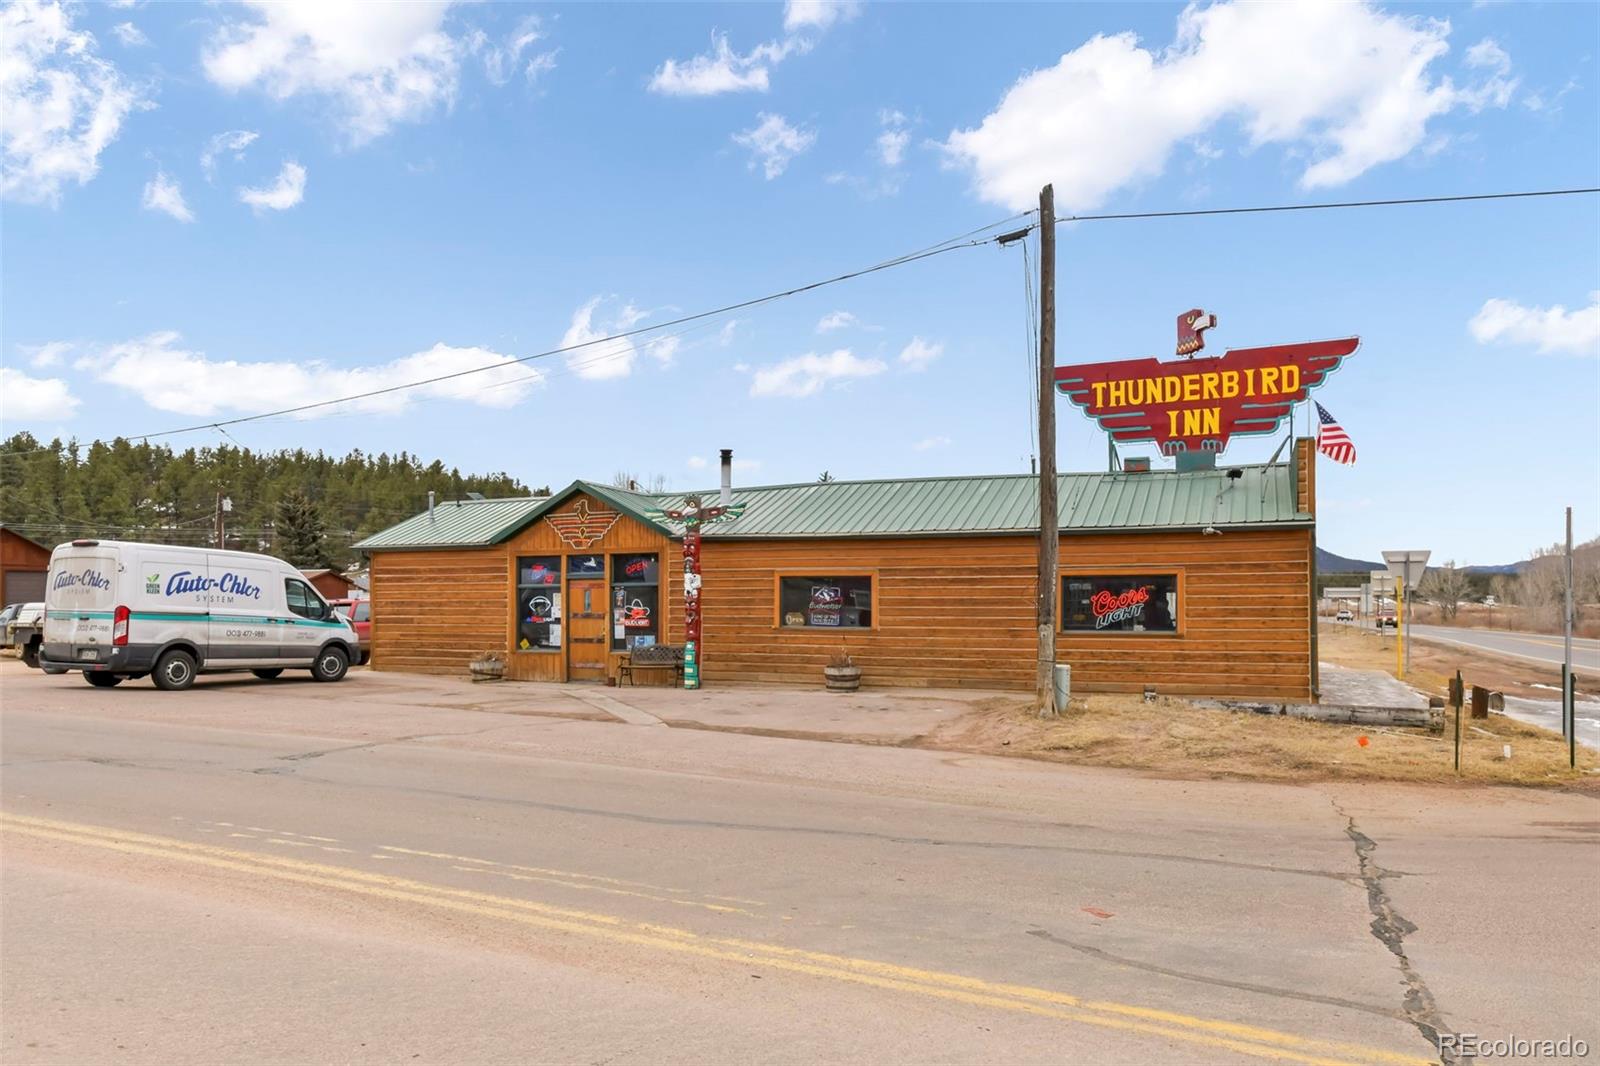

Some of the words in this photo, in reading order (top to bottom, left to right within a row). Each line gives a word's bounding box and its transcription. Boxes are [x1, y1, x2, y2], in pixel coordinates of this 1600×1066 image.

[1091, 365, 1300, 409] THUNDERBIRD
[1167, 407, 1221, 437] INN
[53, 569, 110, 591] Auto-Chlor
[625, 560, 648, 576] OPEN
[165, 571, 261, 600] Auto-Chlor
[196, 595, 234, 603] SYSTEM
[1091, 587, 1149, 617] Coors
[1096, 603, 1144, 629] LIGHT
